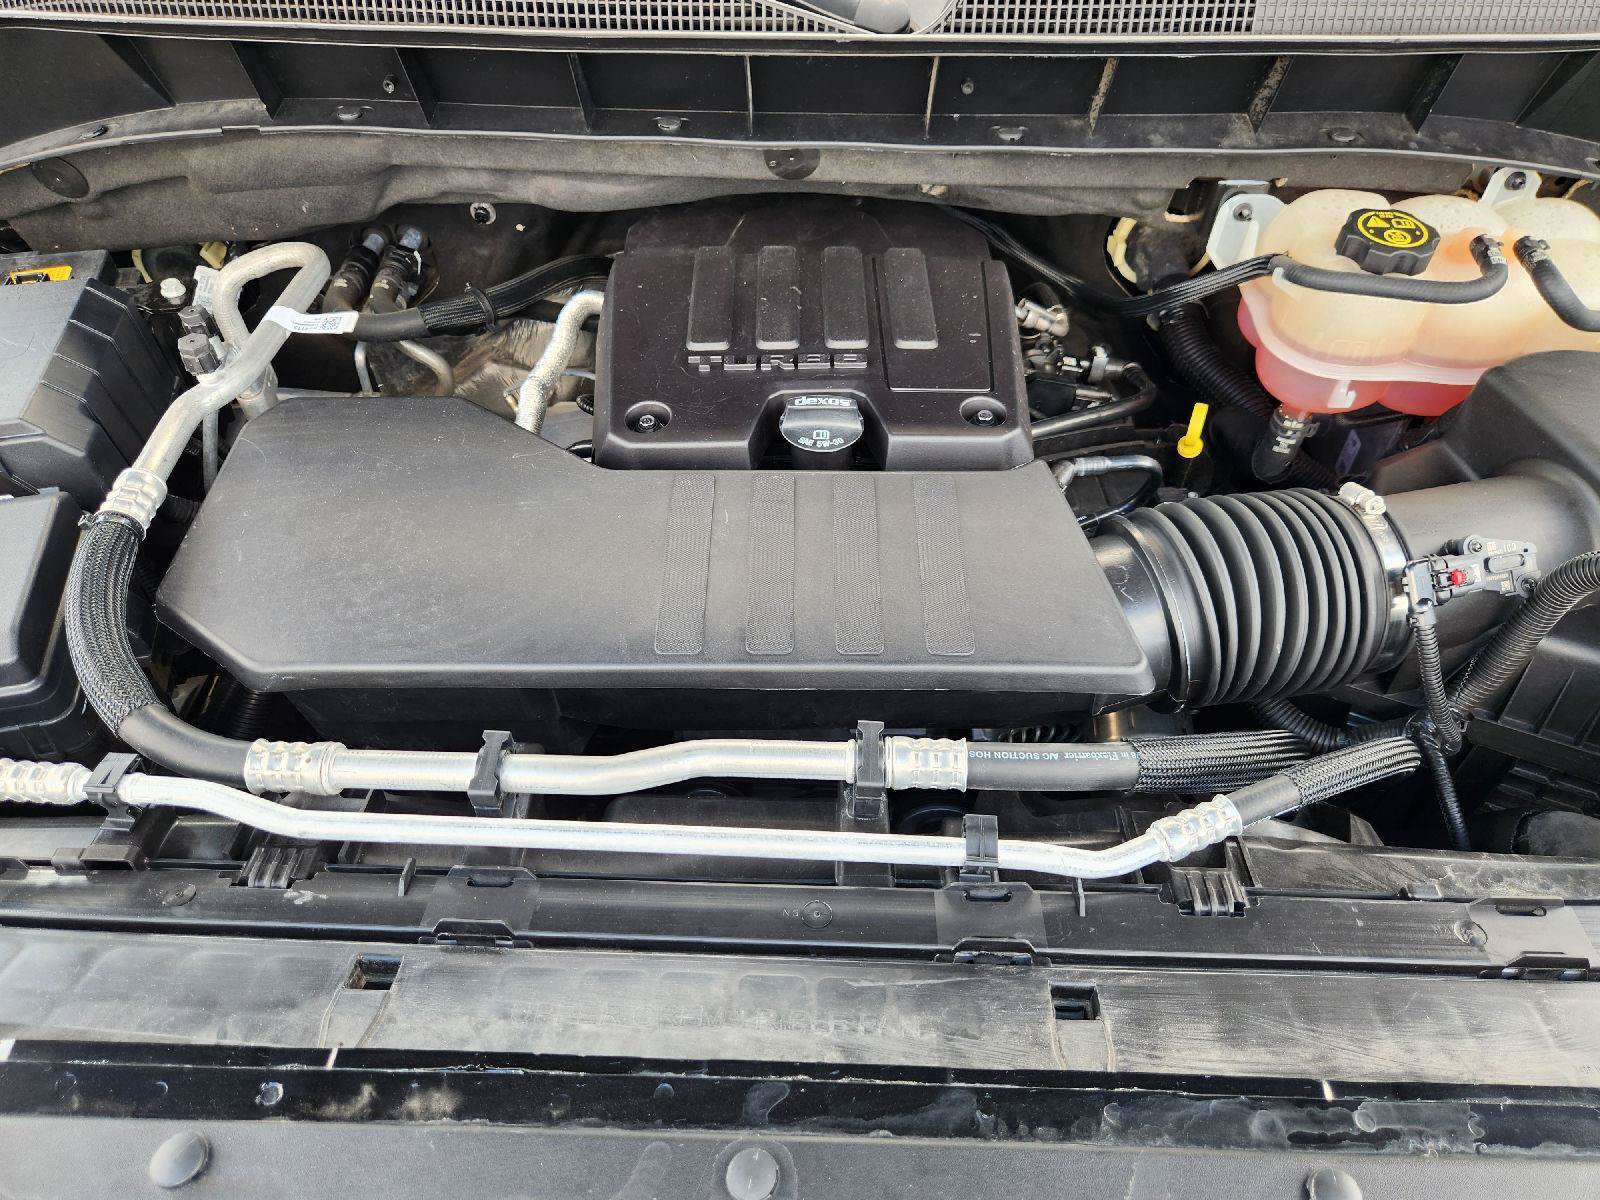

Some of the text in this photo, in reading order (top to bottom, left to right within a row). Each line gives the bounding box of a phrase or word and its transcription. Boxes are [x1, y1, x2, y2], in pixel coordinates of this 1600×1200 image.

[688, 354, 868, 371] TURBO
[794, 395, 851, 407] dexos
[798, 436, 845, 448] SAE 5W-30
[994, 751, 1041, 760] SUCTION
[1064, 751, 1120, 761] Flexbarrier
